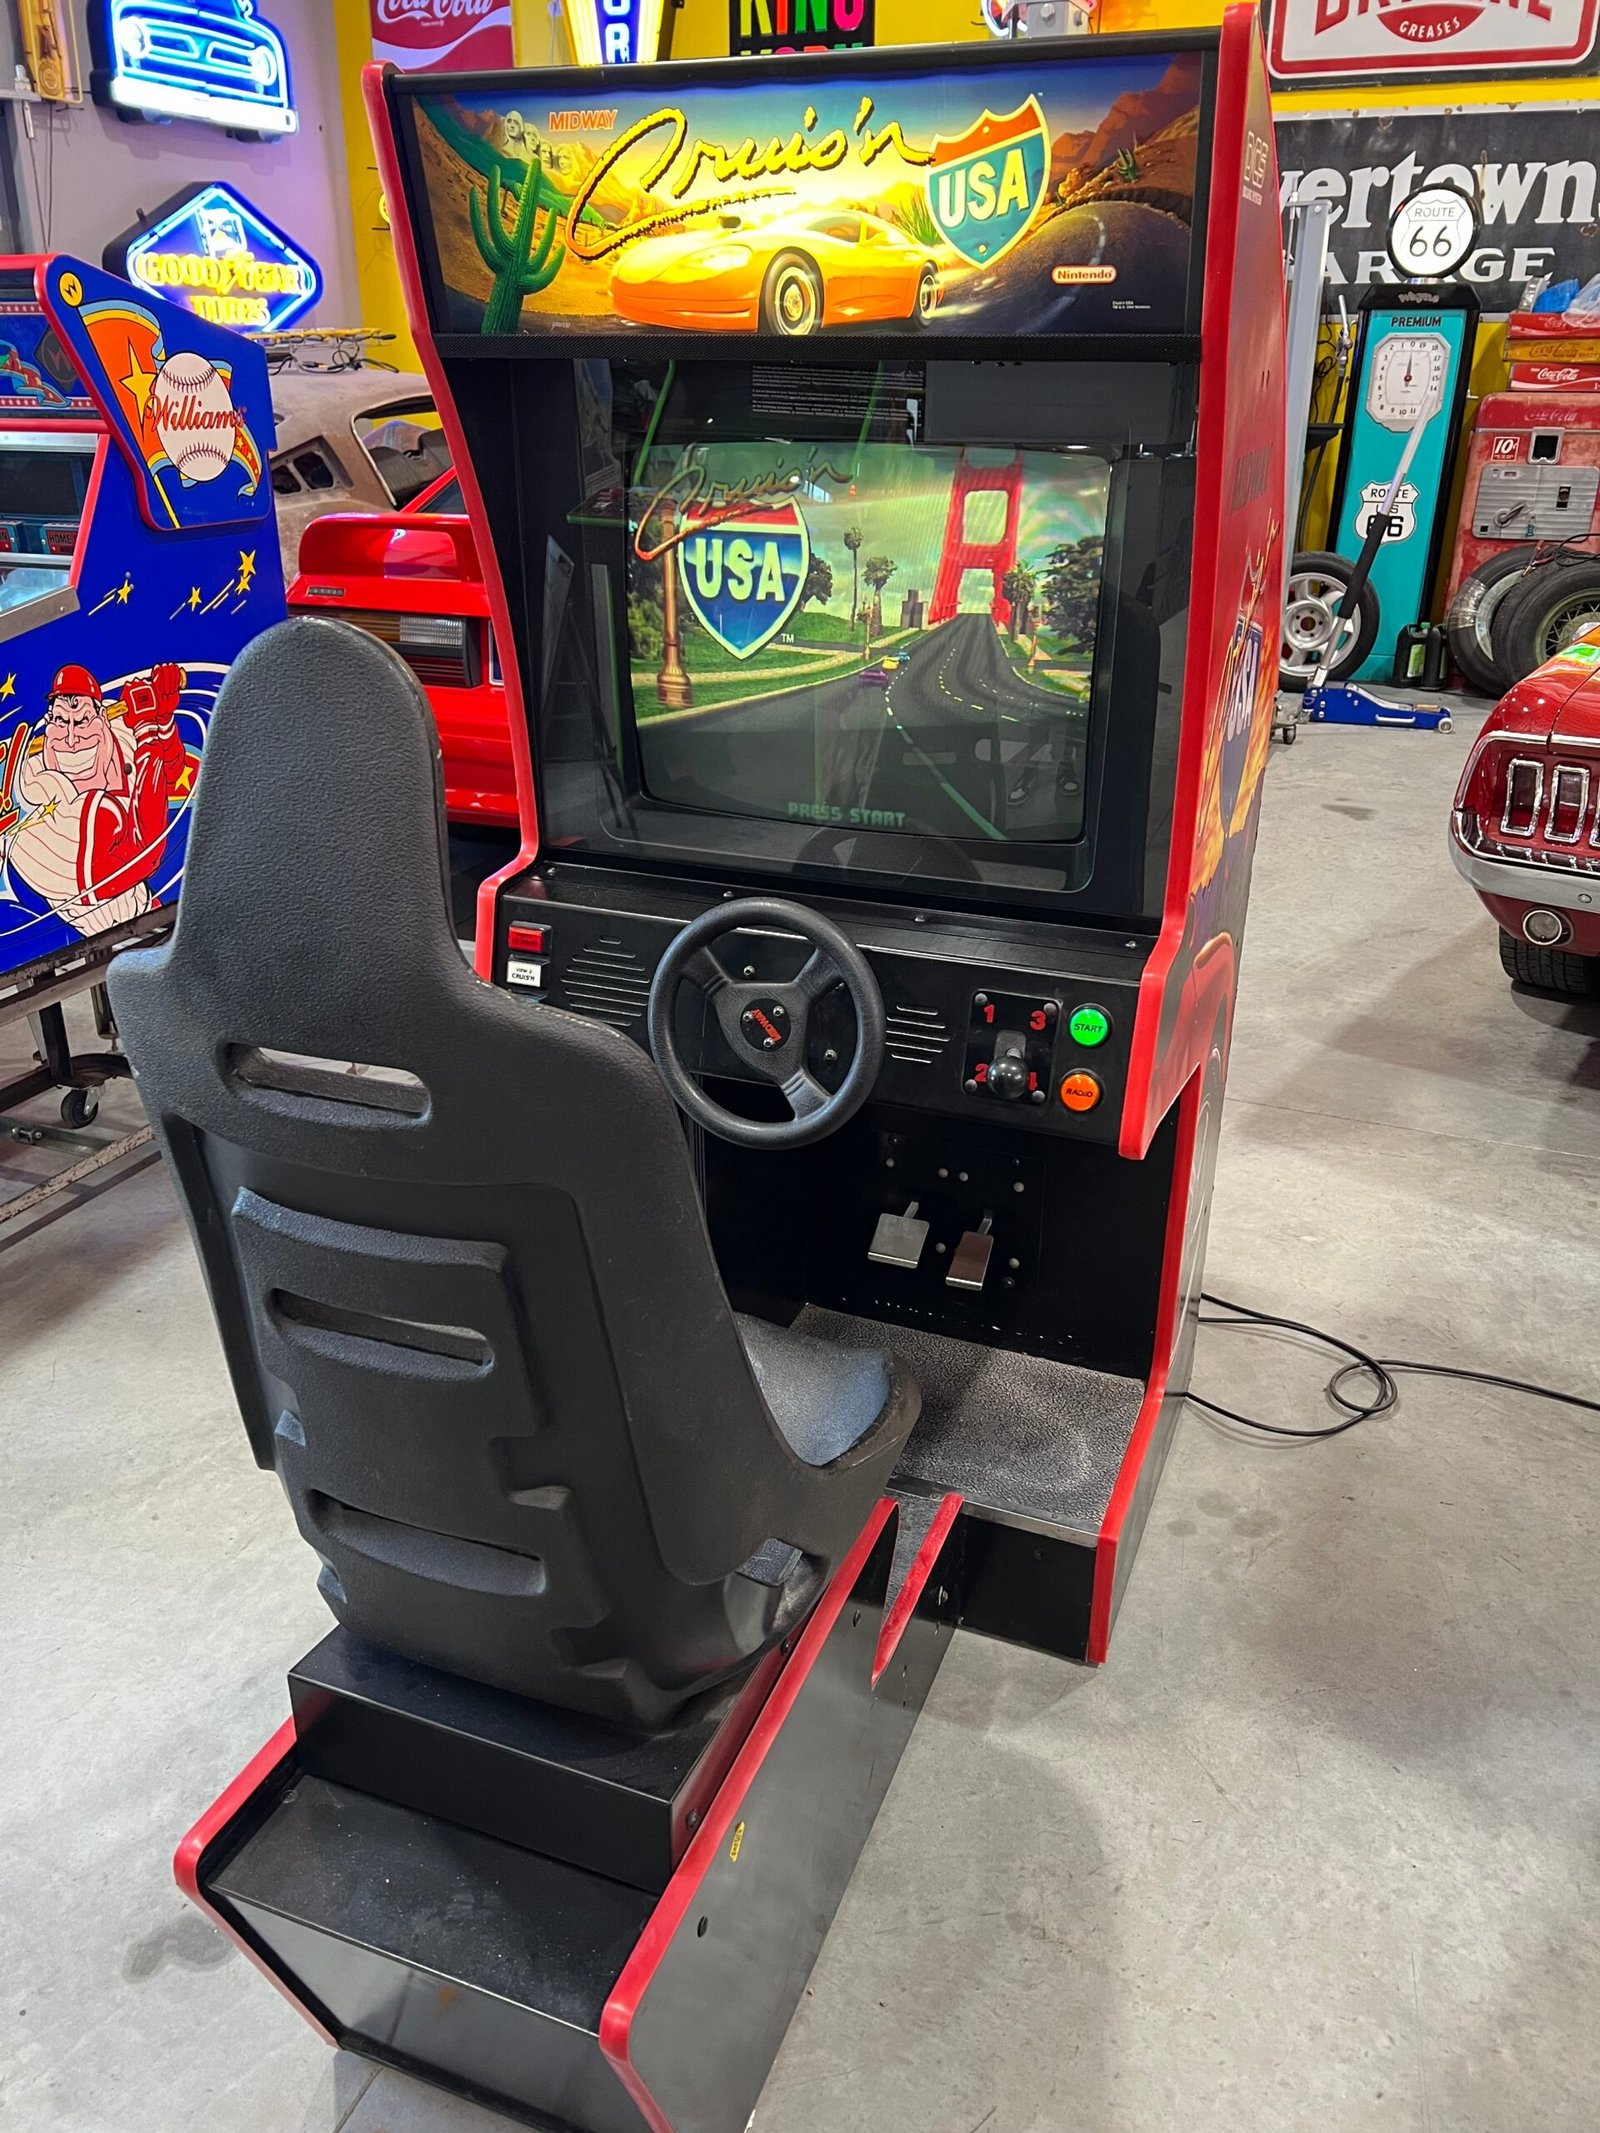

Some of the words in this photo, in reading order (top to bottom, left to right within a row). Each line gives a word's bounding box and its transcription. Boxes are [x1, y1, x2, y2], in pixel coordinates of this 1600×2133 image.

[1400, 16, 1460, 38] GREASES
[549, 109, 618, 131] MIDWAY
[938, 149, 1029, 228] USA
[1414, 207, 1456, 218] ROUTE
[1409, 225, 1452, 257] 66
[1057, 269, 1113, 280] Nintendo
[1391, 316, 1442, 328] PREMIUM
[145, 393, 245, 432] Williams
[1371, 488, 1408, 499] ROTE
[695, 538, 785, 601] USA
[781, 634, 795, 643] TM
[788, 802, 842, 821] PRESS
[850, 808, 906, 827] START
[984, 1004, 995, 1023] 1
[1030, 1010, 1047, 1031] 3
[1074, 1023, 1103, 1033] START
[974, 1063, 989, 1083] 2
[1065, 1088, 1094, 1098] RADIO
